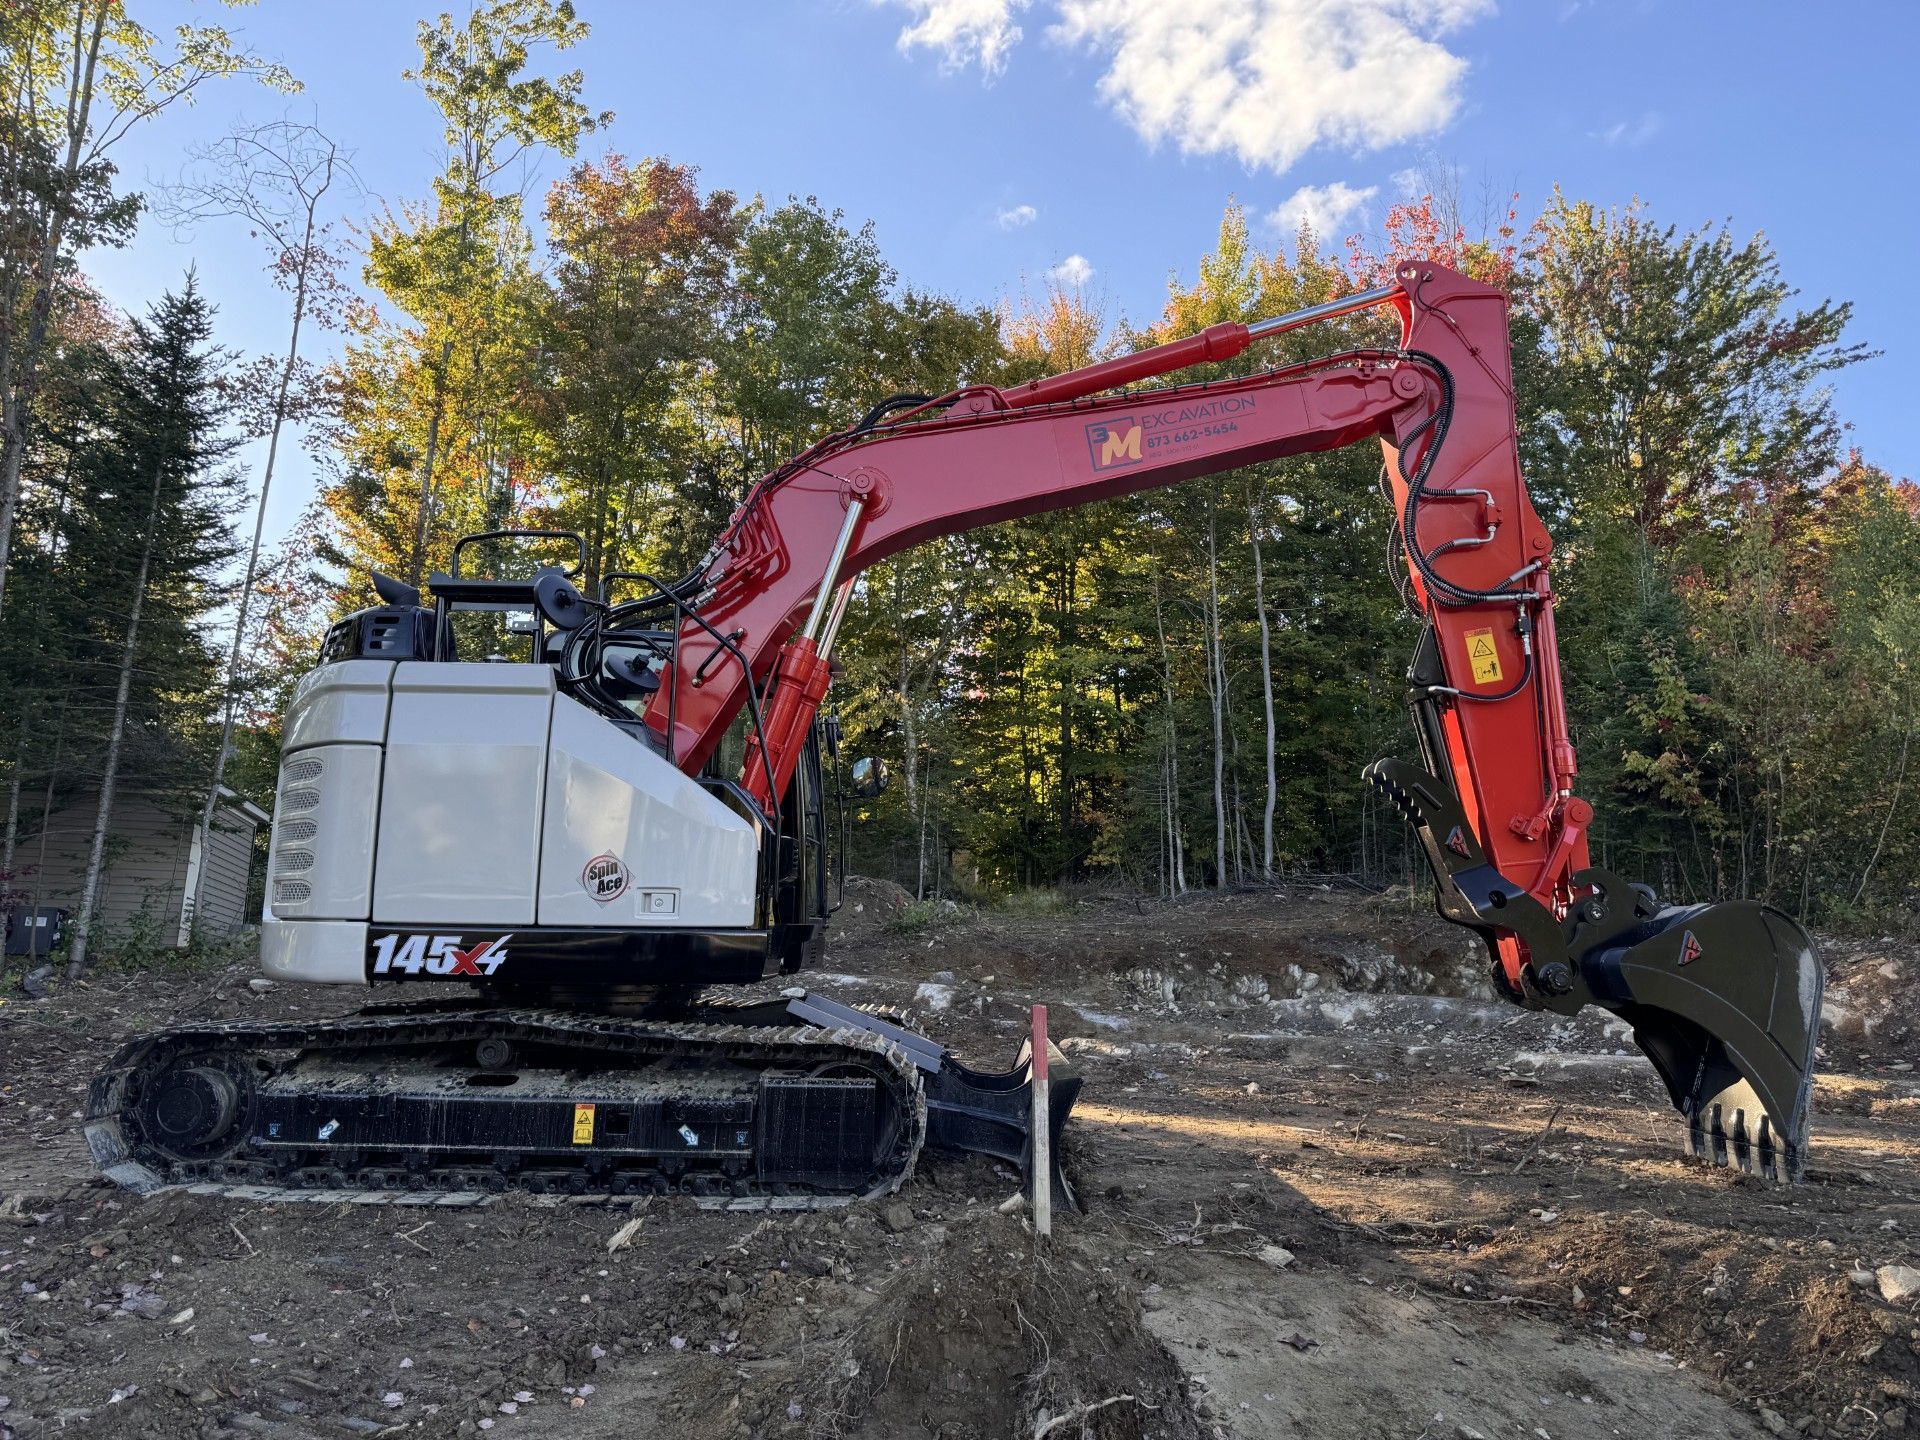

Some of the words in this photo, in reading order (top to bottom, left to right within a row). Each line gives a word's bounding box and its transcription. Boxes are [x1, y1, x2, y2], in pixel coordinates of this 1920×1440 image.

[1141, 394, 1256, 430] EXCAVATION
[1147, 435, 1171, 449] 873
[1174, 421, 1238, 444] 662-5454
[589, 861, 619, 881] Spin
[596, 876, 623, 895] Ace
